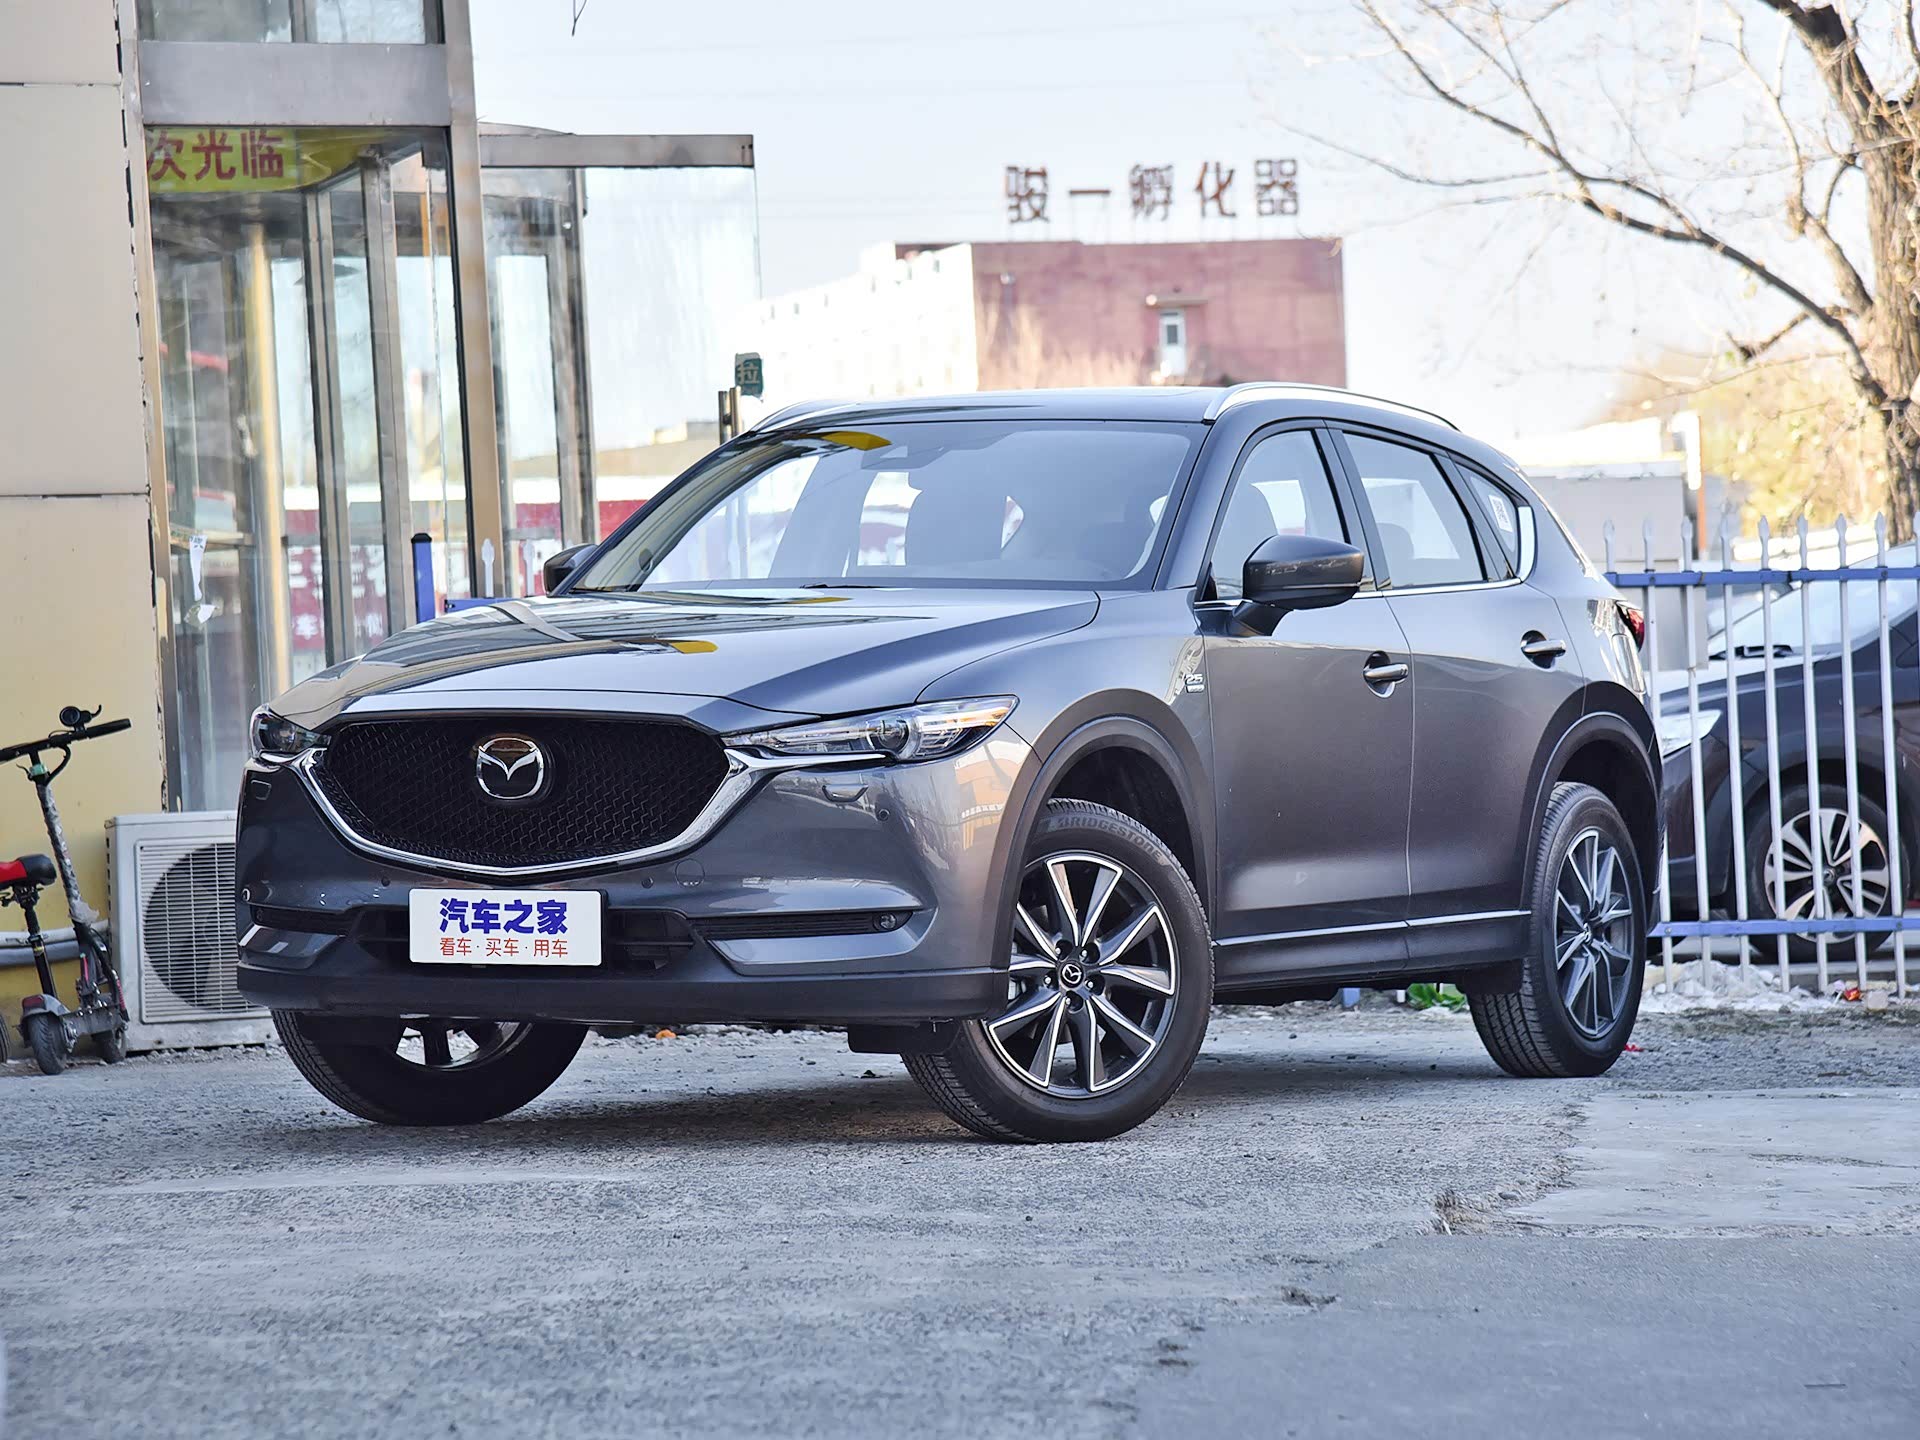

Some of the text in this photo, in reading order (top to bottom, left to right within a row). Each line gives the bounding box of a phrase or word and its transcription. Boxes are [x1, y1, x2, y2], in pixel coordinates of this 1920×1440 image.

[146, 128, 284, 181] 次光临
[439, 897, 569, 935] 汽车之家
